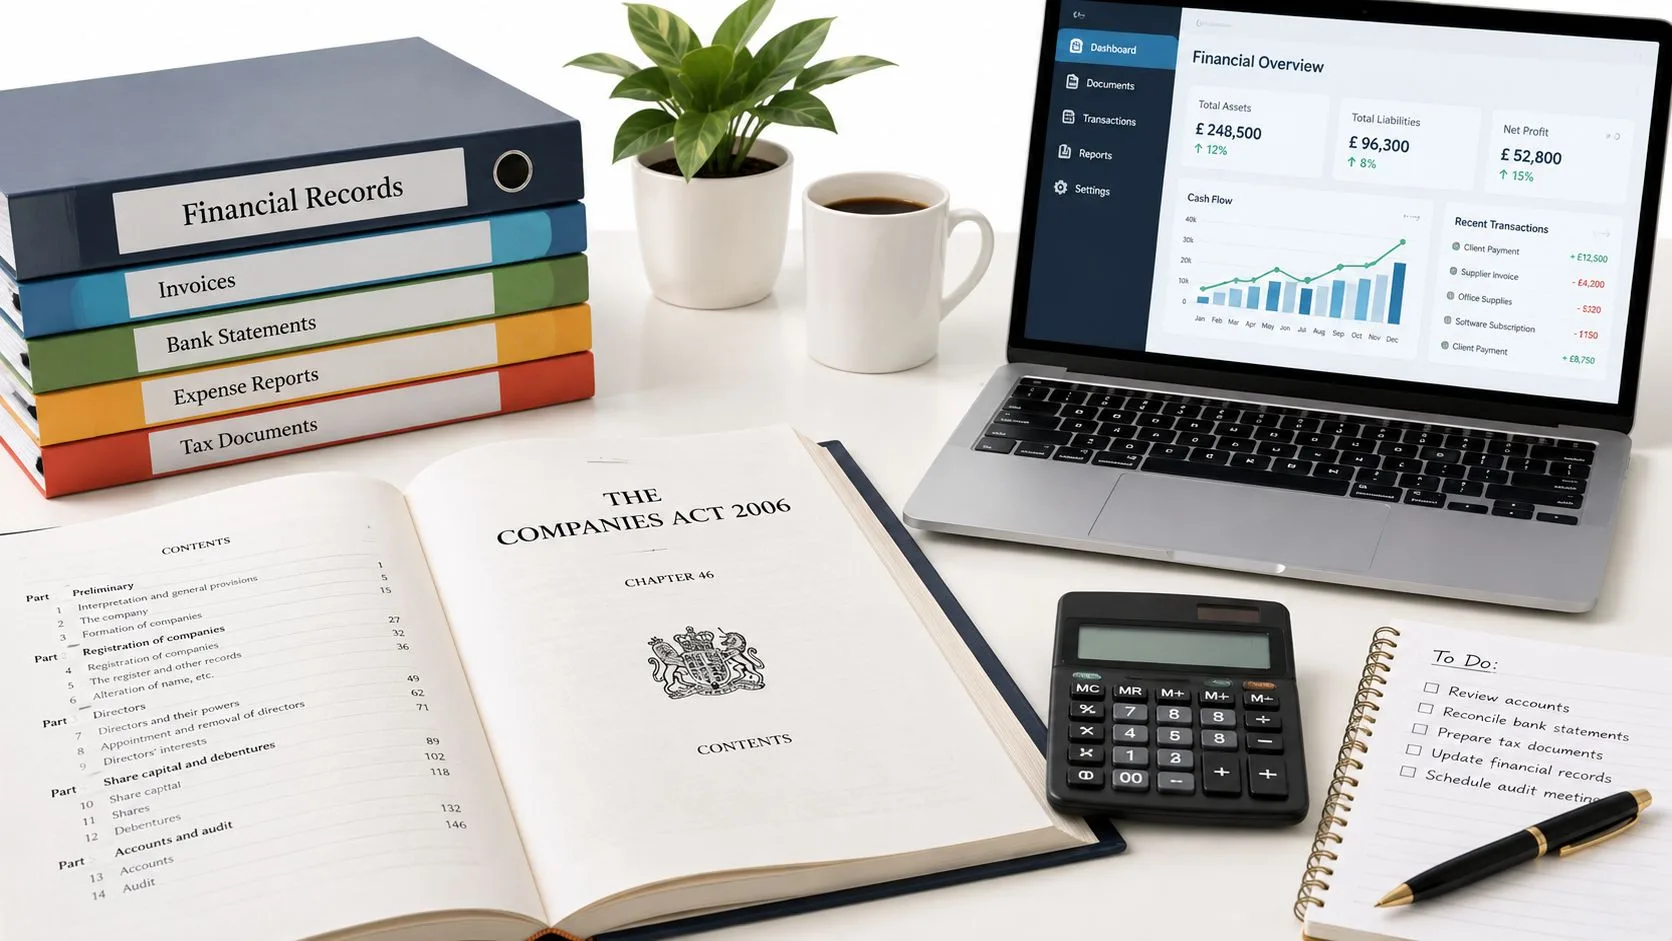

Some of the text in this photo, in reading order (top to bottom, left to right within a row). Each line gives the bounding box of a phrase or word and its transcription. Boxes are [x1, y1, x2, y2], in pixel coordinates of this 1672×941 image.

[1090, 43, 1137, 55] Dashboard
[1193, 50, 1325, 73] Financial Overview
[1086, 78, 1135, 91] Documents
[1199, 100, 1252, 113] Total Assets
[1083, 114, 1137, 127] Transactions
[1352, 113, 1421, 127] Total Liabilities
[1196, 122, 1262, 141] £ 248,500
[1504, 125, 1549, 137] Net Profit
[1207, 144, 1228, 156] 12%
[1349, 136, 1410, 153] £ 96,300
[1080, 149, 1113, 161] Reports
[1360, 158, 1377, 169] 8%
[1500, 148, 1562, 165] £ 52,800
[1512, 171, 1534, 182] 15%
[1074, 184, 1111, 197] Settings
[1188, 194, 1233, 205] Cash Flow
[182, 176, 404, 226] Financial Records
[1455, 217, 1549, 234] Recent Transactions
[1464, 244, 1520, 256] Client Payment
[1461, 268, 1519, 281] Supplier Invoice
[158, 274, 236, 299] Invoices
[1458, 292, 1513, 306] Office Supplies
[166, 316, 317, 354] Bank Statements
[1455, 318, 1536, 334] Software Subscription
[1332, 330, 1345, 339] Sep
[1386, 336, 1399, 344] Dec
[1452, 343, 1508, 356] Client Payment
[173, 368, 320, 407] Expense Reports
[180, 418, 318, 456] Tax Documents
[602, 488, 662, 507] THE
[496, 498, 791, 546] COMPANIES ACT 2006
[162, 536, 231, 555] CONTENTS
[624, 570, 715, 588] CHAPTER 46
[26, 582, 134, 603] Part Preliminary
[78, 576, 258, 612] Interpretation and general provisions
[80, 608, 149, 624] The company
[388, 616, 400, 624] 27
[82, 612, 203, 639] Formation of companies
[34, 626, 226, 663] Part Registration of companies
[396, 643, 410, 651] 36
[88, 642, 219, 672] Registration of companies
[1433, 650, 1498, 670] To Do:
[90, 651, 243, 686] The register and other records
[93, 670, 214, 700] Alteration of name, etc.
[407, 675, 420, 683] 49
[411, 689, 425, 697] 62
[1076, 684, 1100, 694] MC
[1119, 686, 1142, 696] MR
[1449, 686, 1570, 713] Review accounts
[42, 702, 146, 728] Part Directors
[98, 700, 240, 736] Directors and their powers
[100, 700, 305, 752] Appointment and removal of directors
[1443, 707, 1630, 742] Reconcile bank statements
[160, 738, 208, 754] interests
[426, 737, 440, 746] 89
[697, 734, 793, 755] CONTENTS
[1438, 728, 1603, 760] Prepare tax documents
[425, 753, 445, 761] 102
[51, 740, 276, 798] Part Share capital and debentures
[430, 768, 450, 777] 118
[1432, 749, 1612, 784] Update financial records
[1426, 770, 1492, 789] Schedule
[1498, 780, 1538, 796] audit
[80, 790, 141, 810] 10 Share
[441, 804, 461, 813] 132
[83, 804, 150, 826] 11 Shares
[86, 813, 182, 843] 12 Debentures
[446, 820, 467, 830] 146
[58, 820, 233, 870] Part Accounts and audit
[90, 855, 174, 883] 13 Accounts
[92, 878, 156, 901] 14 Audit
